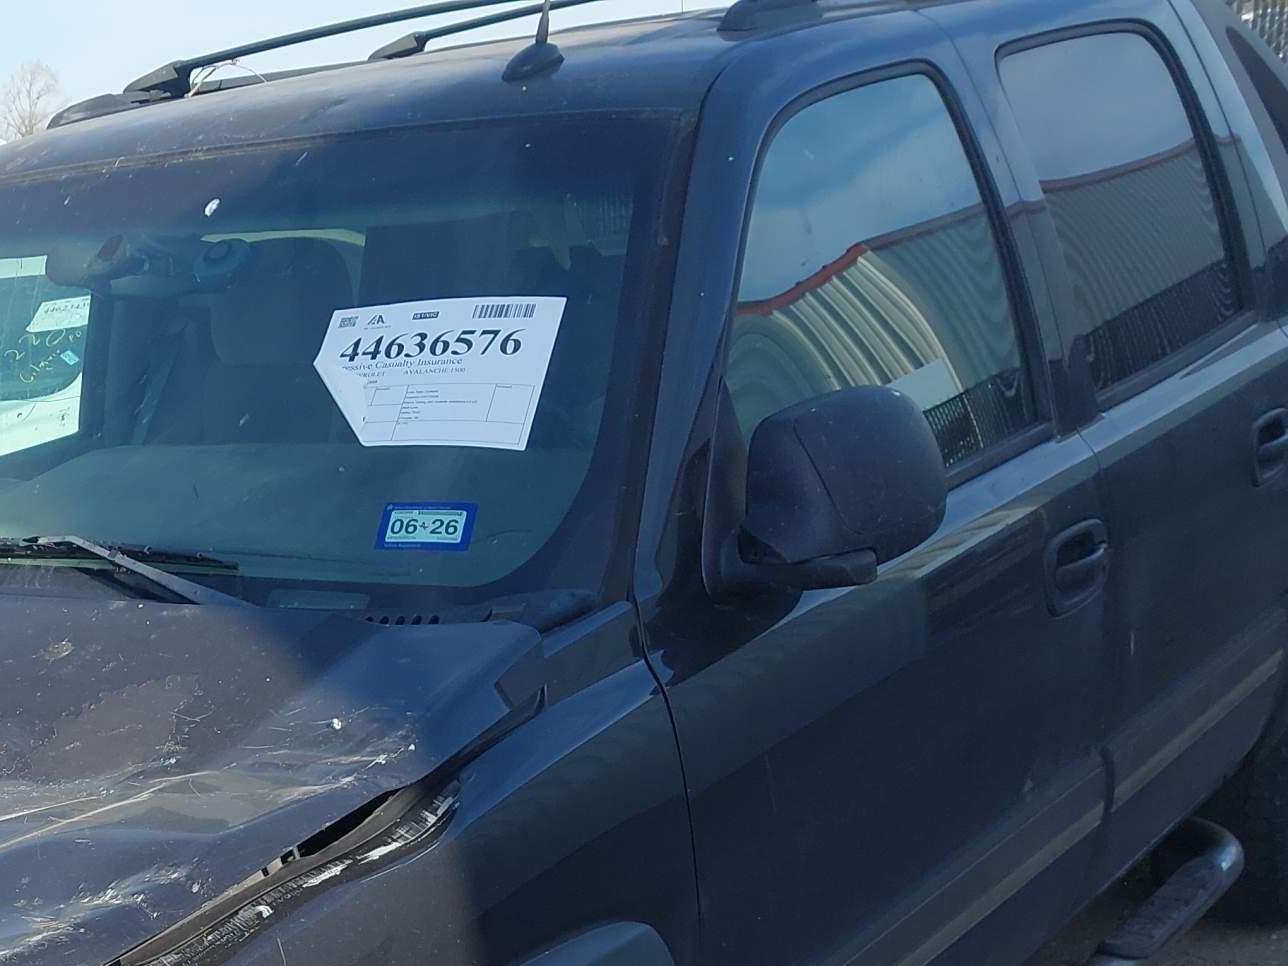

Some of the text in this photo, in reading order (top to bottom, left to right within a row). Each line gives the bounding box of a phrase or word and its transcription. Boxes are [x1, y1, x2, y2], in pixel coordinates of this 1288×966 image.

[340, 329, 527, 362] 44636576
[375, 359, 415, 369] Casualty
[417, 358, 463, 367] Insurance
[390, 518, 460, 536] 06 26
